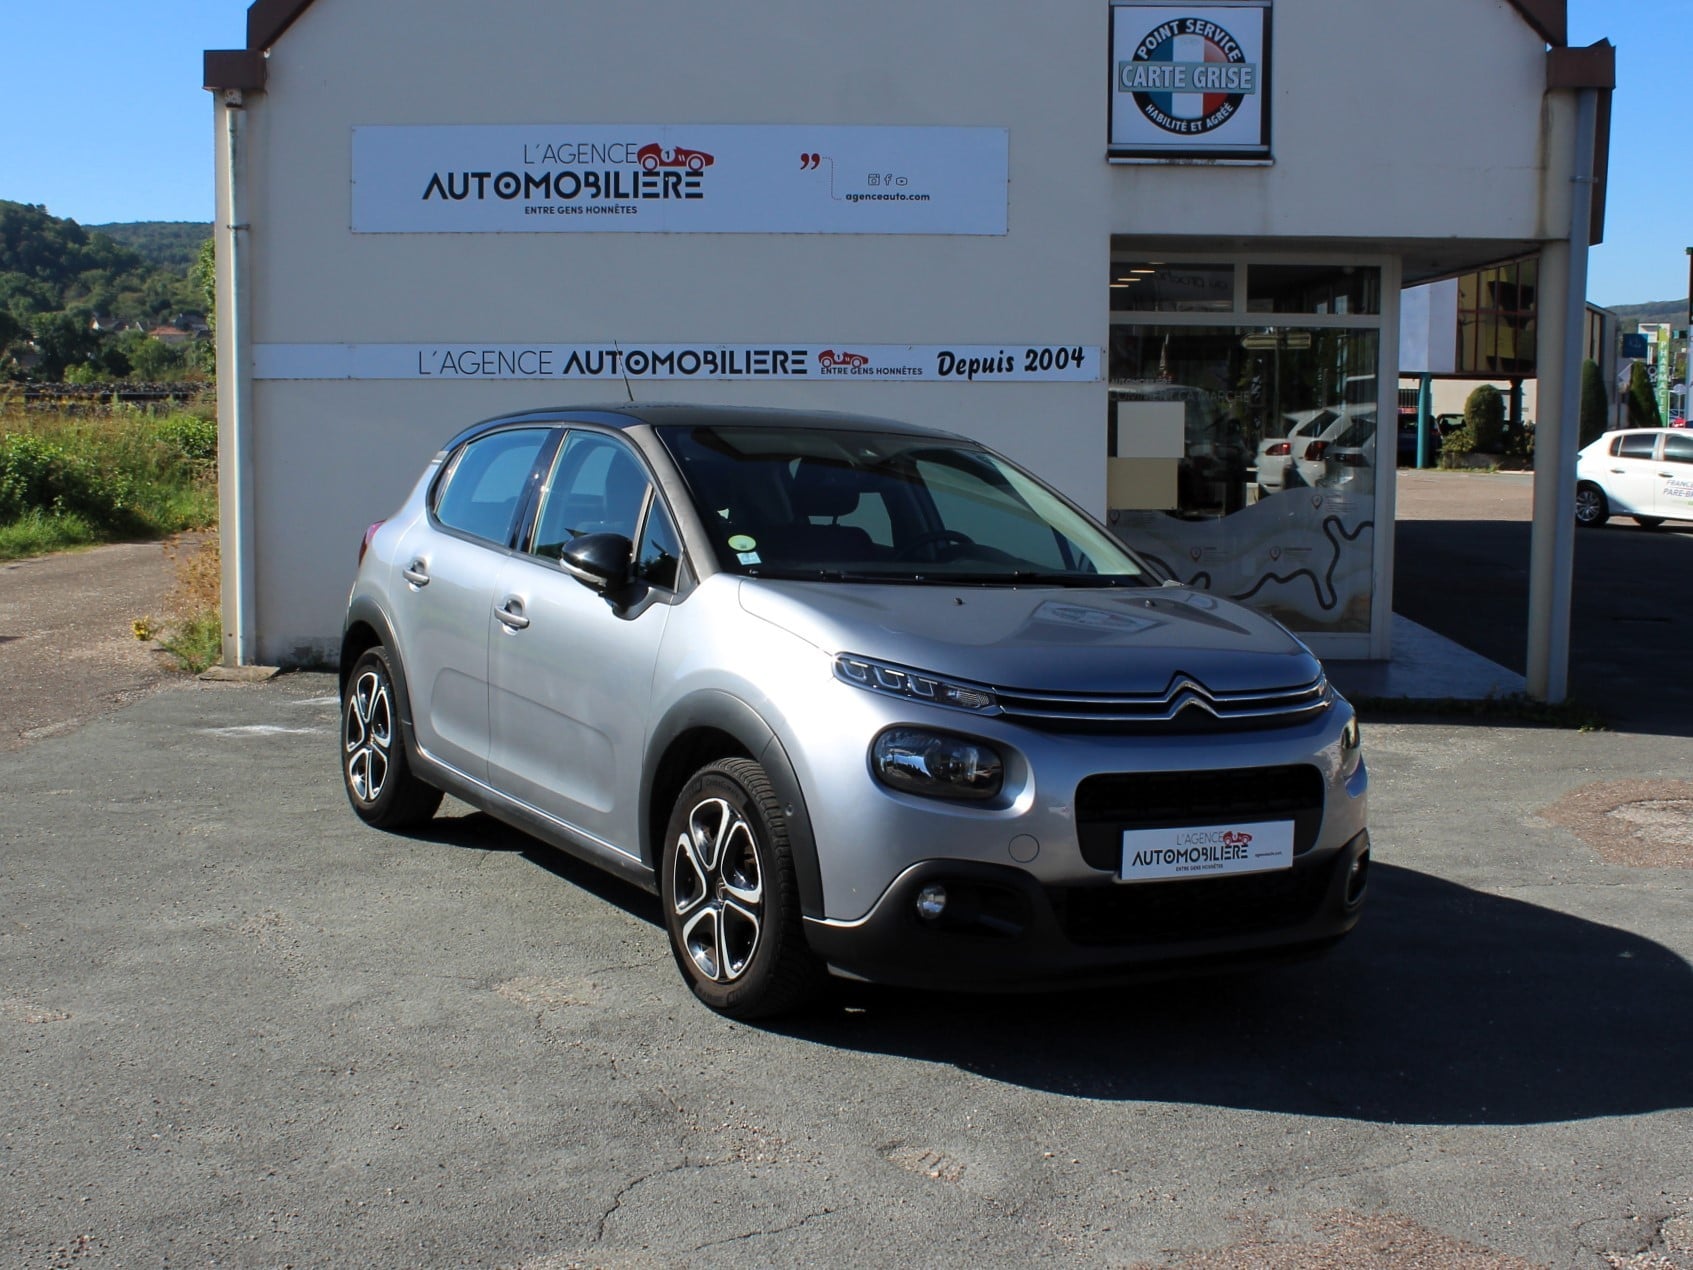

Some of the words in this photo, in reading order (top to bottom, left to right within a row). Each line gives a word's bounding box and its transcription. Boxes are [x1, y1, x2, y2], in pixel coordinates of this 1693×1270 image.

[1137, 21, 1180, 60] POINT
[1185, 19, 1242, 63] SERVICE
[1121, 65, 1187, 88] CARTE
[1193, 66, 1252, 89] GRISE
[1190, 121, 1203, 132] ET
[845, 192, 931, 203] agenceauto.com
[524, 206, 556, 215] ENTRE
[557, 206, 584, 215] GENS
[585, 203, 638, 215] HONNÊTES
[820, 367, 849, 375] ENTRE
[850, 367, 875, 376] GENS
[876, 365, 923, 376] HONNÊTES
[937, 350, 1015, 380] Depuis
[1024, 346, 1086, 372] 2004
[1658, 341, 1669, 414] PHARMACIE
